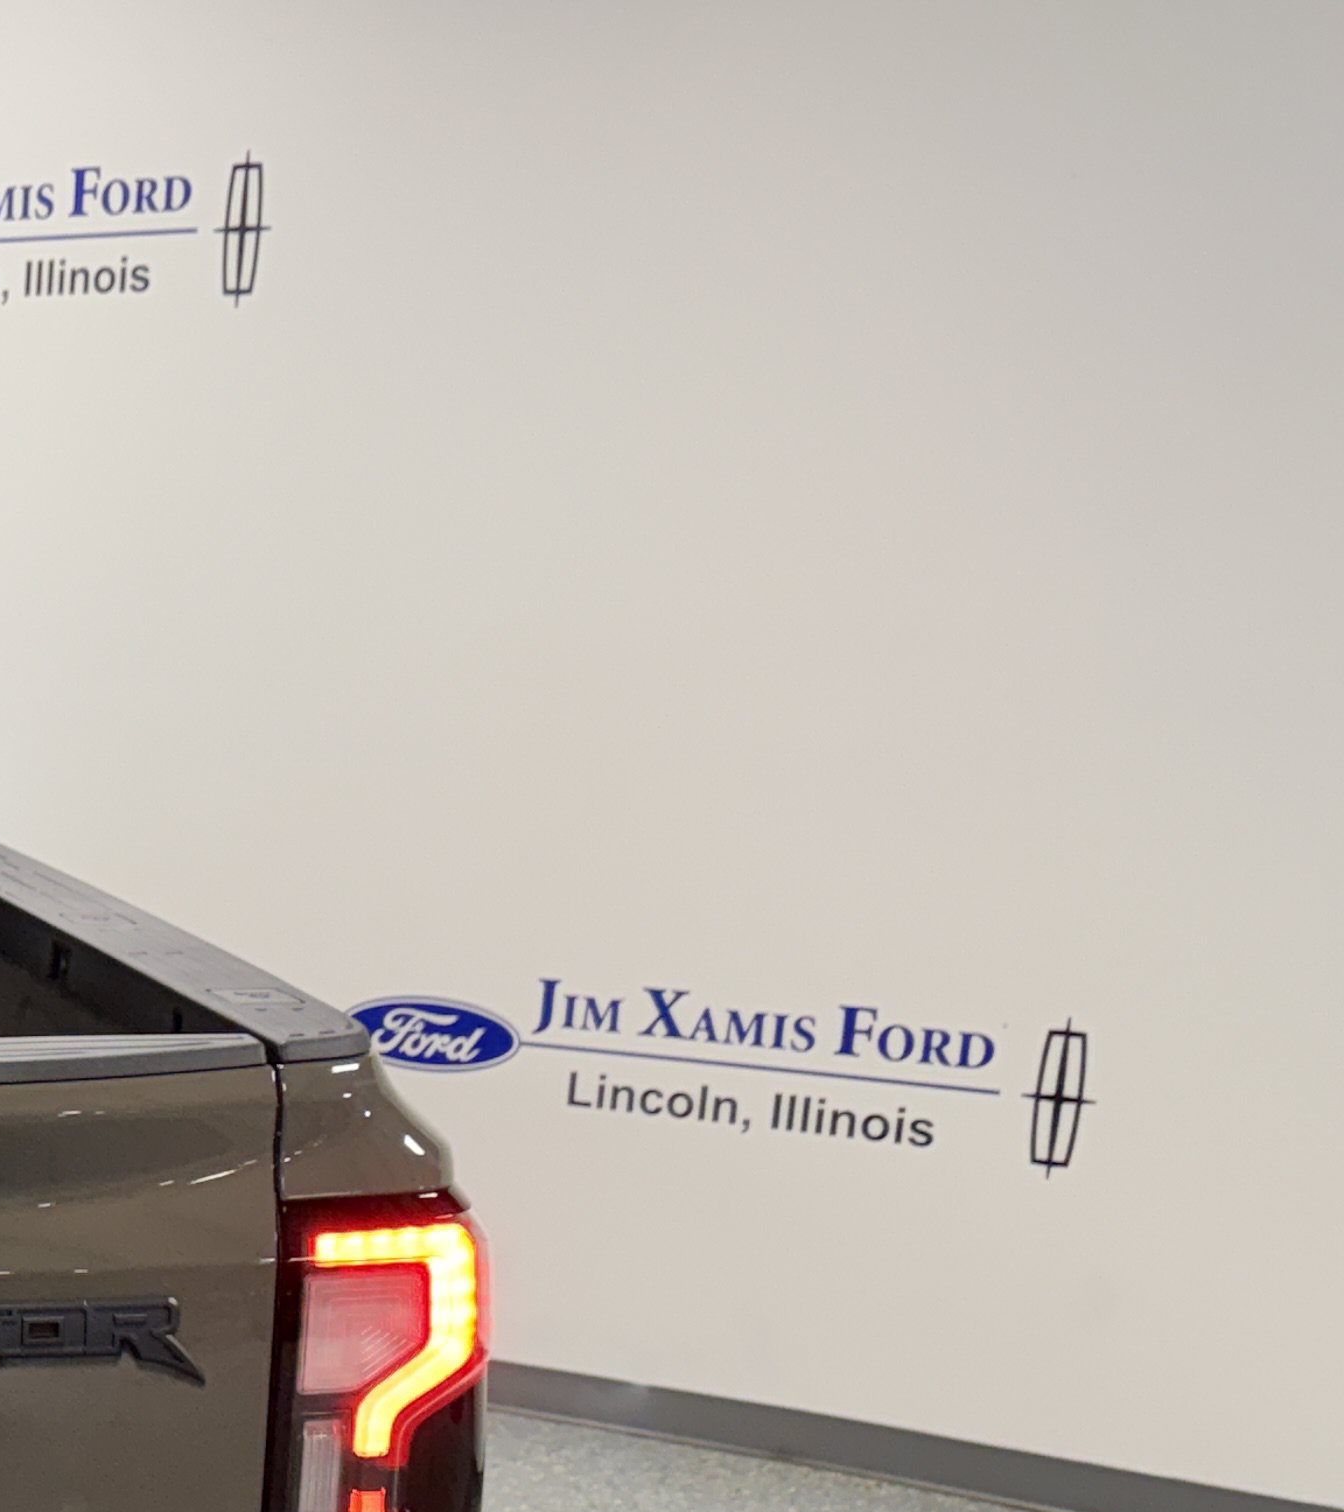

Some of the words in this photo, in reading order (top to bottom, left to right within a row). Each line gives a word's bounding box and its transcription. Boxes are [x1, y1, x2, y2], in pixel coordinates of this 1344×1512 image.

[69, 165, 193, 219] FORD
[23, 255, 151, 297] Illinois
[369, 1006, 487, 1064] Ford
[530, 977, 621, 1035] JIM
[640, 987, 817, 1053] XAMIS
[833, 1004, 996, 1072] FORD
[565, 1072, 752, 1134] Lincoln,
[769, 1092, 936, 1148] Illinois
